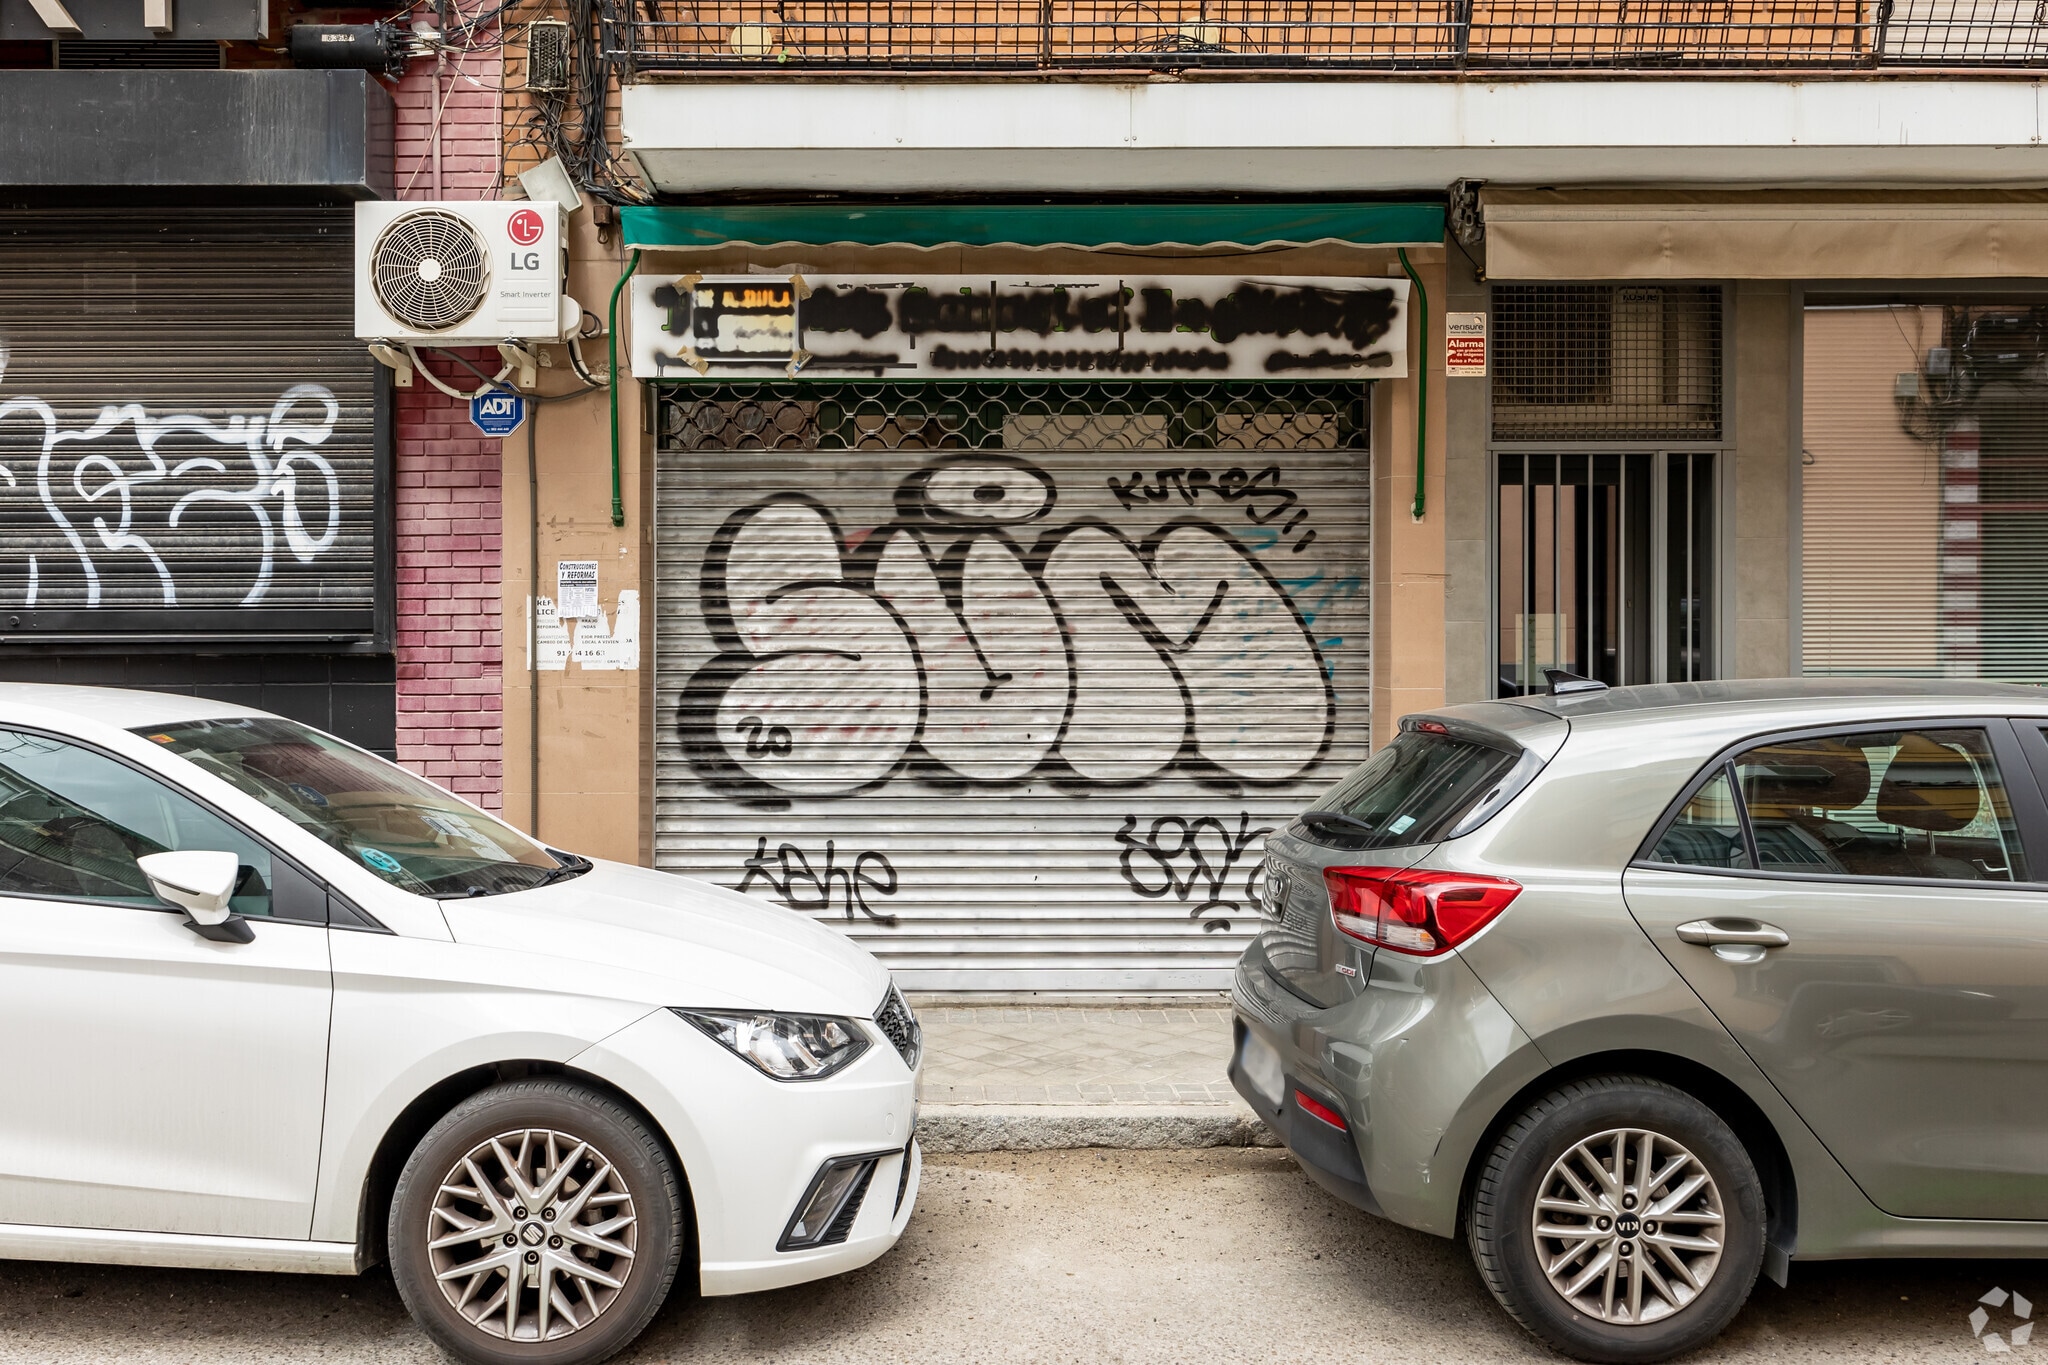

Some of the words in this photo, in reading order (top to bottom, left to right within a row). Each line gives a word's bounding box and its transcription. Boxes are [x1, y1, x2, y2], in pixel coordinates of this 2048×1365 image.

[511, 252, 540, 271] LG
[1448, 339, 1484, 348] Alarma
[481, 398, 515, 415] ADT
[560, 562, 597, 570] CONSTRUCCIONES
[562, 571, 566, 579] Y
[567, 571, 596, 579] REFORMAS
[1617, 1221, 1639, 1231] KIA
